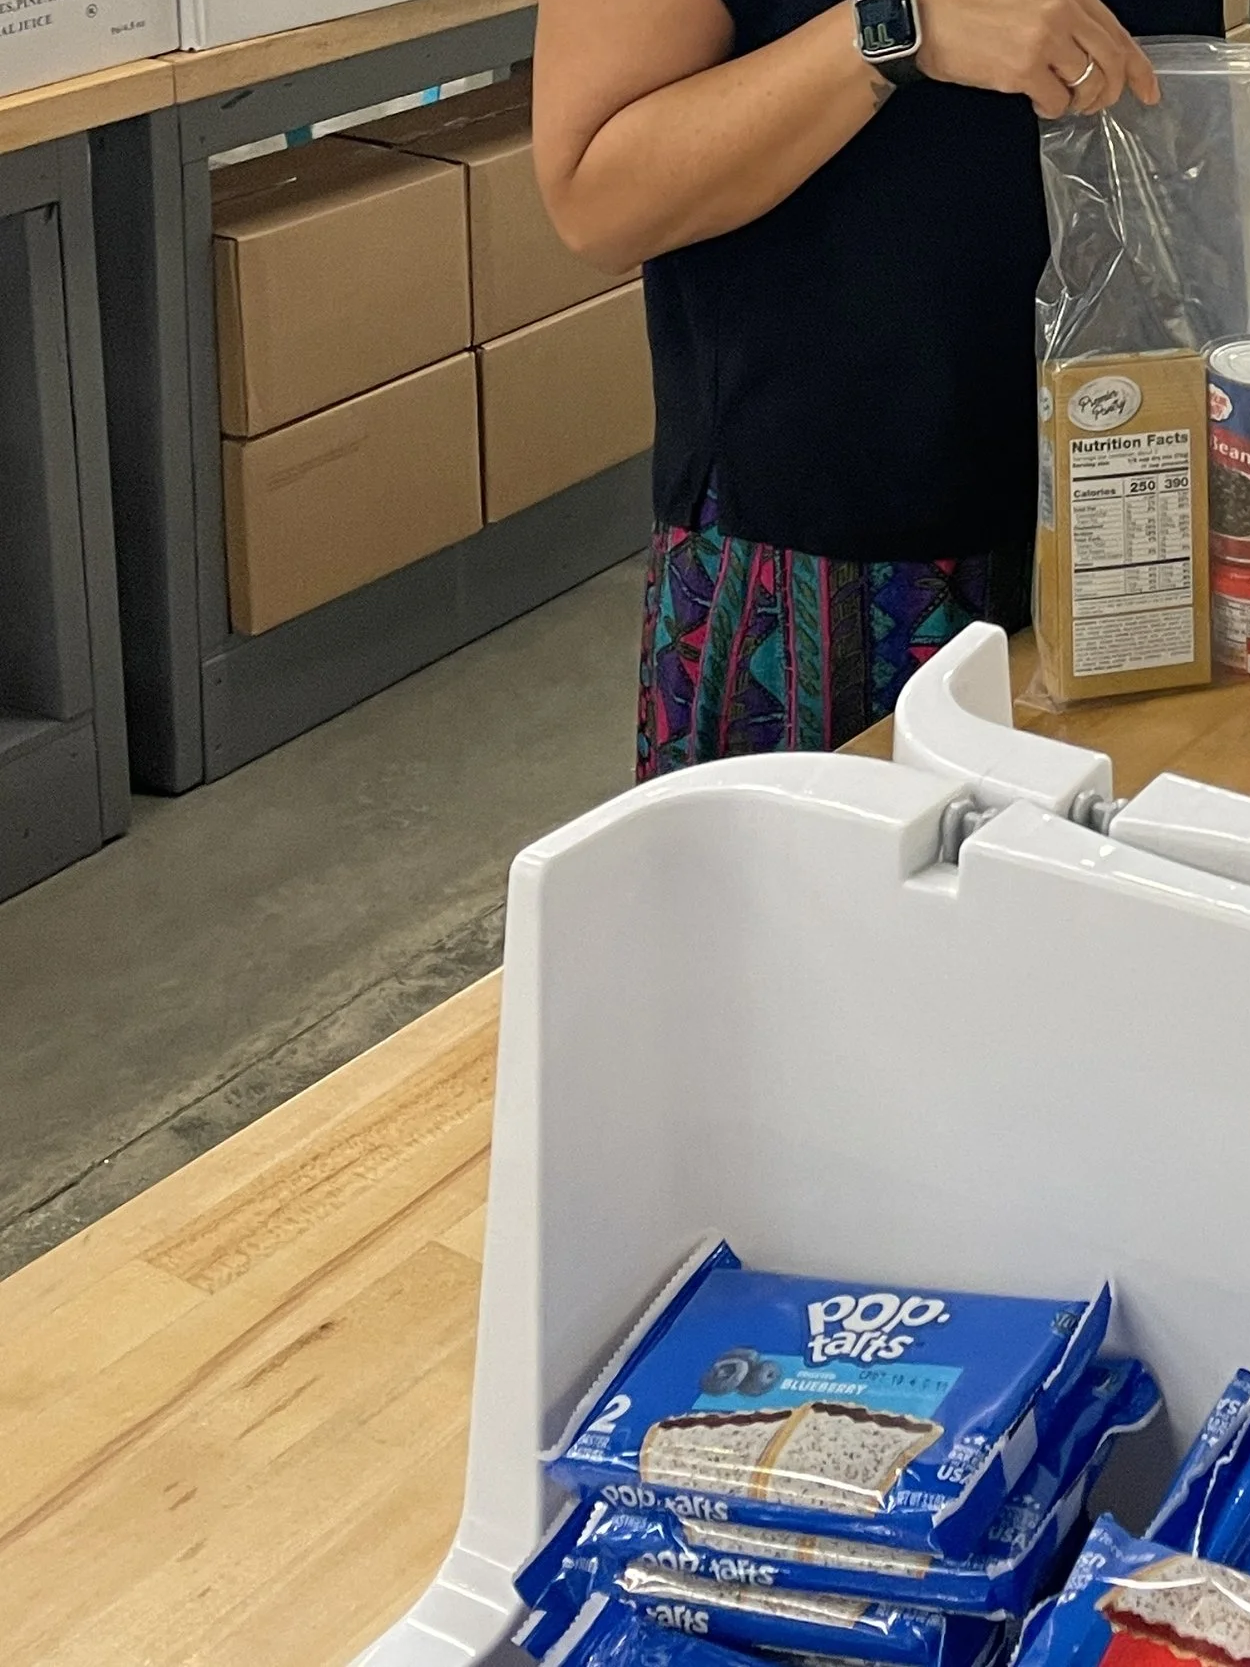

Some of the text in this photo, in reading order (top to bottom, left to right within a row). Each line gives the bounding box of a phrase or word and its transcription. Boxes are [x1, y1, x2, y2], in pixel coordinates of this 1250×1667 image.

[1071, 432, 1189, 455] Nutrition Facts
[1073, 476, 1190, 499] Calories 250 390
[807, 1330, 915, 1363] tarts
[779, 1378, 869, 1396] BLUEBERRY
[586, 1394, 632, 1434] 2
[664, 1492, 728, 1523] tarts
[707, 1555, 779, 1586] tarts
